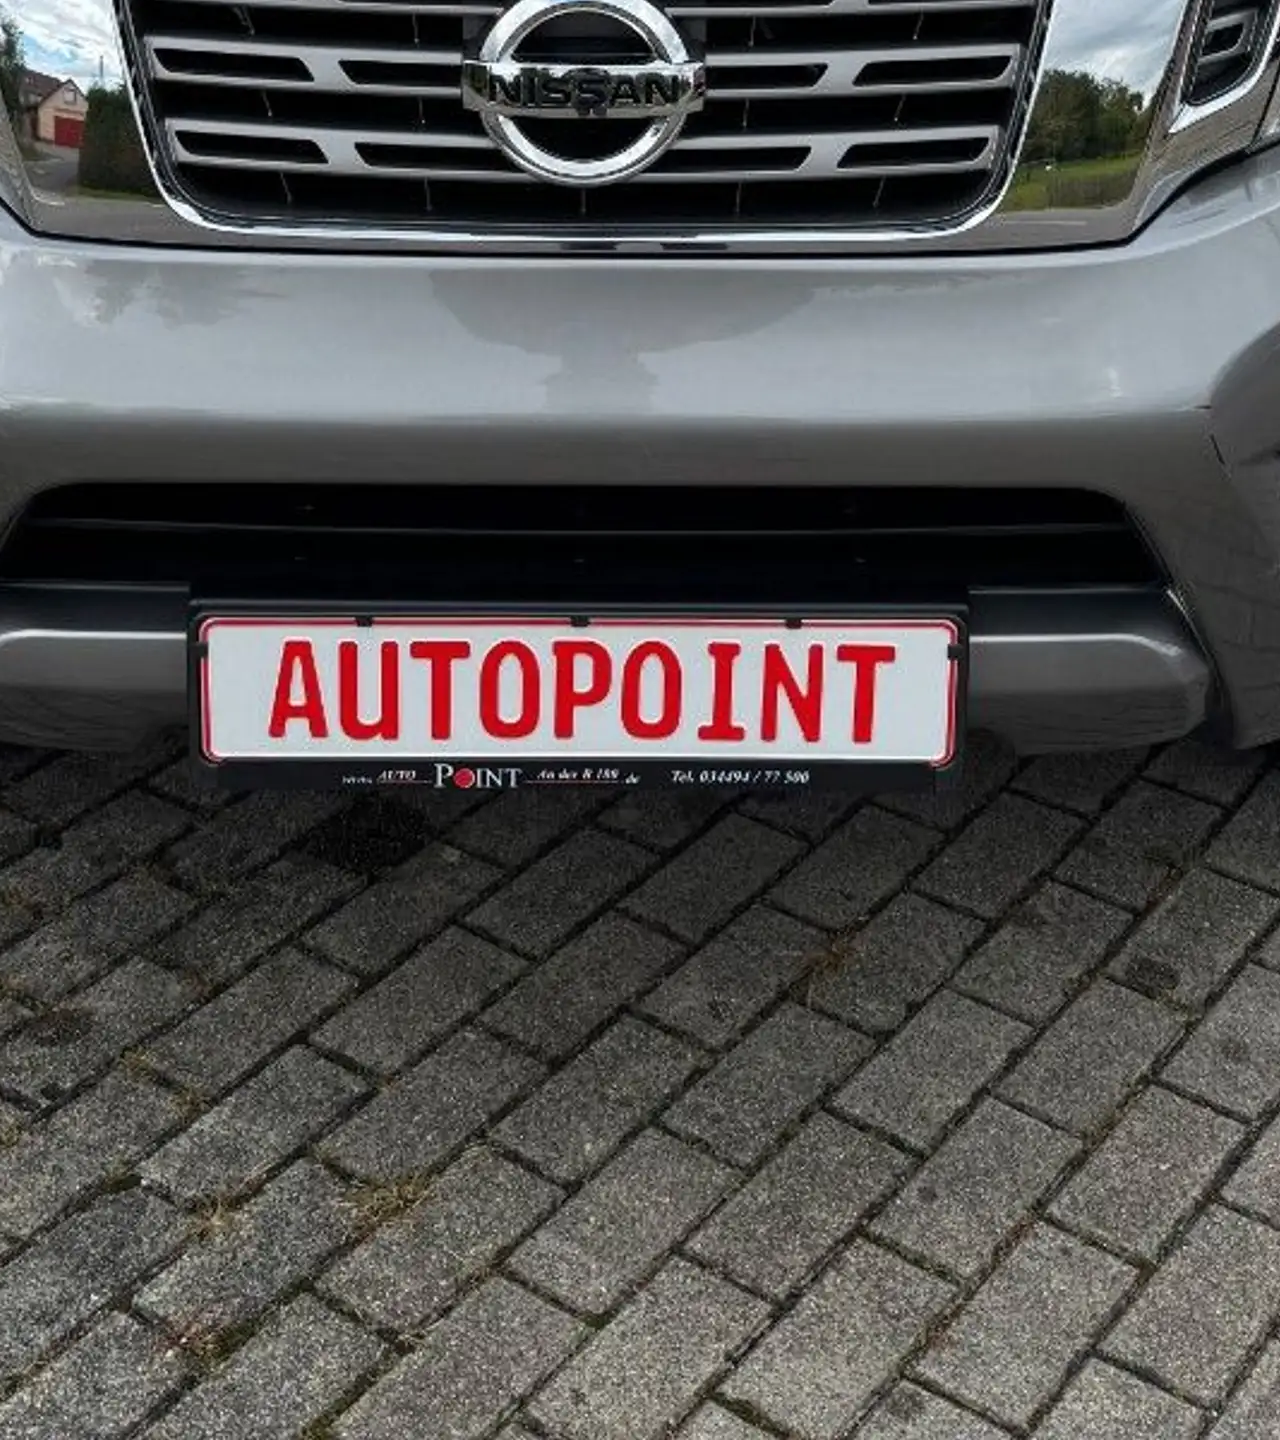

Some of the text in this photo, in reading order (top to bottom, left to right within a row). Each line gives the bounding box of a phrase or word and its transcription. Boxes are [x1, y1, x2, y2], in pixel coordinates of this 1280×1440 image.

[489, 67, 678, 109] NISSAN
[267, 640, 896, 744] AUTOPOINT
[433, 762, 522, 789] POINT
